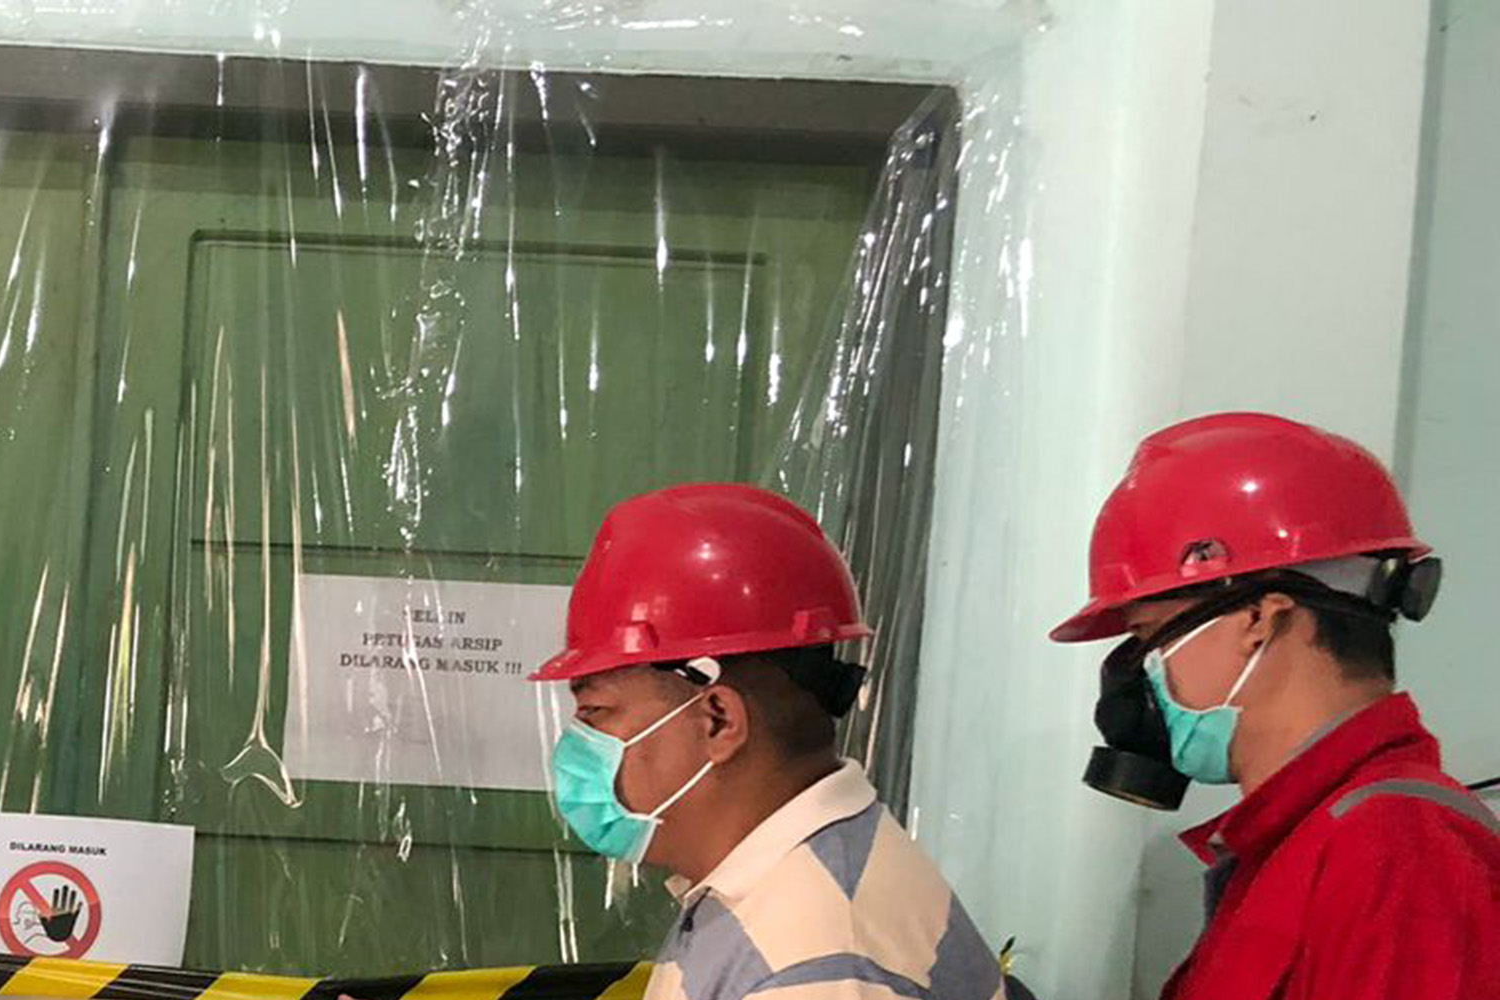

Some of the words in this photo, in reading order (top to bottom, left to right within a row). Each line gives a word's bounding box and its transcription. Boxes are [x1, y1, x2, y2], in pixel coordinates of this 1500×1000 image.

[451, 636, 503, 651] ARSIP
[436, 658, 499, 673] MASUK
[505, 662, 522, 674] !!!
[9, 842, 66, 853] DILARANG
[69, 846, 107, 856] MASUK
